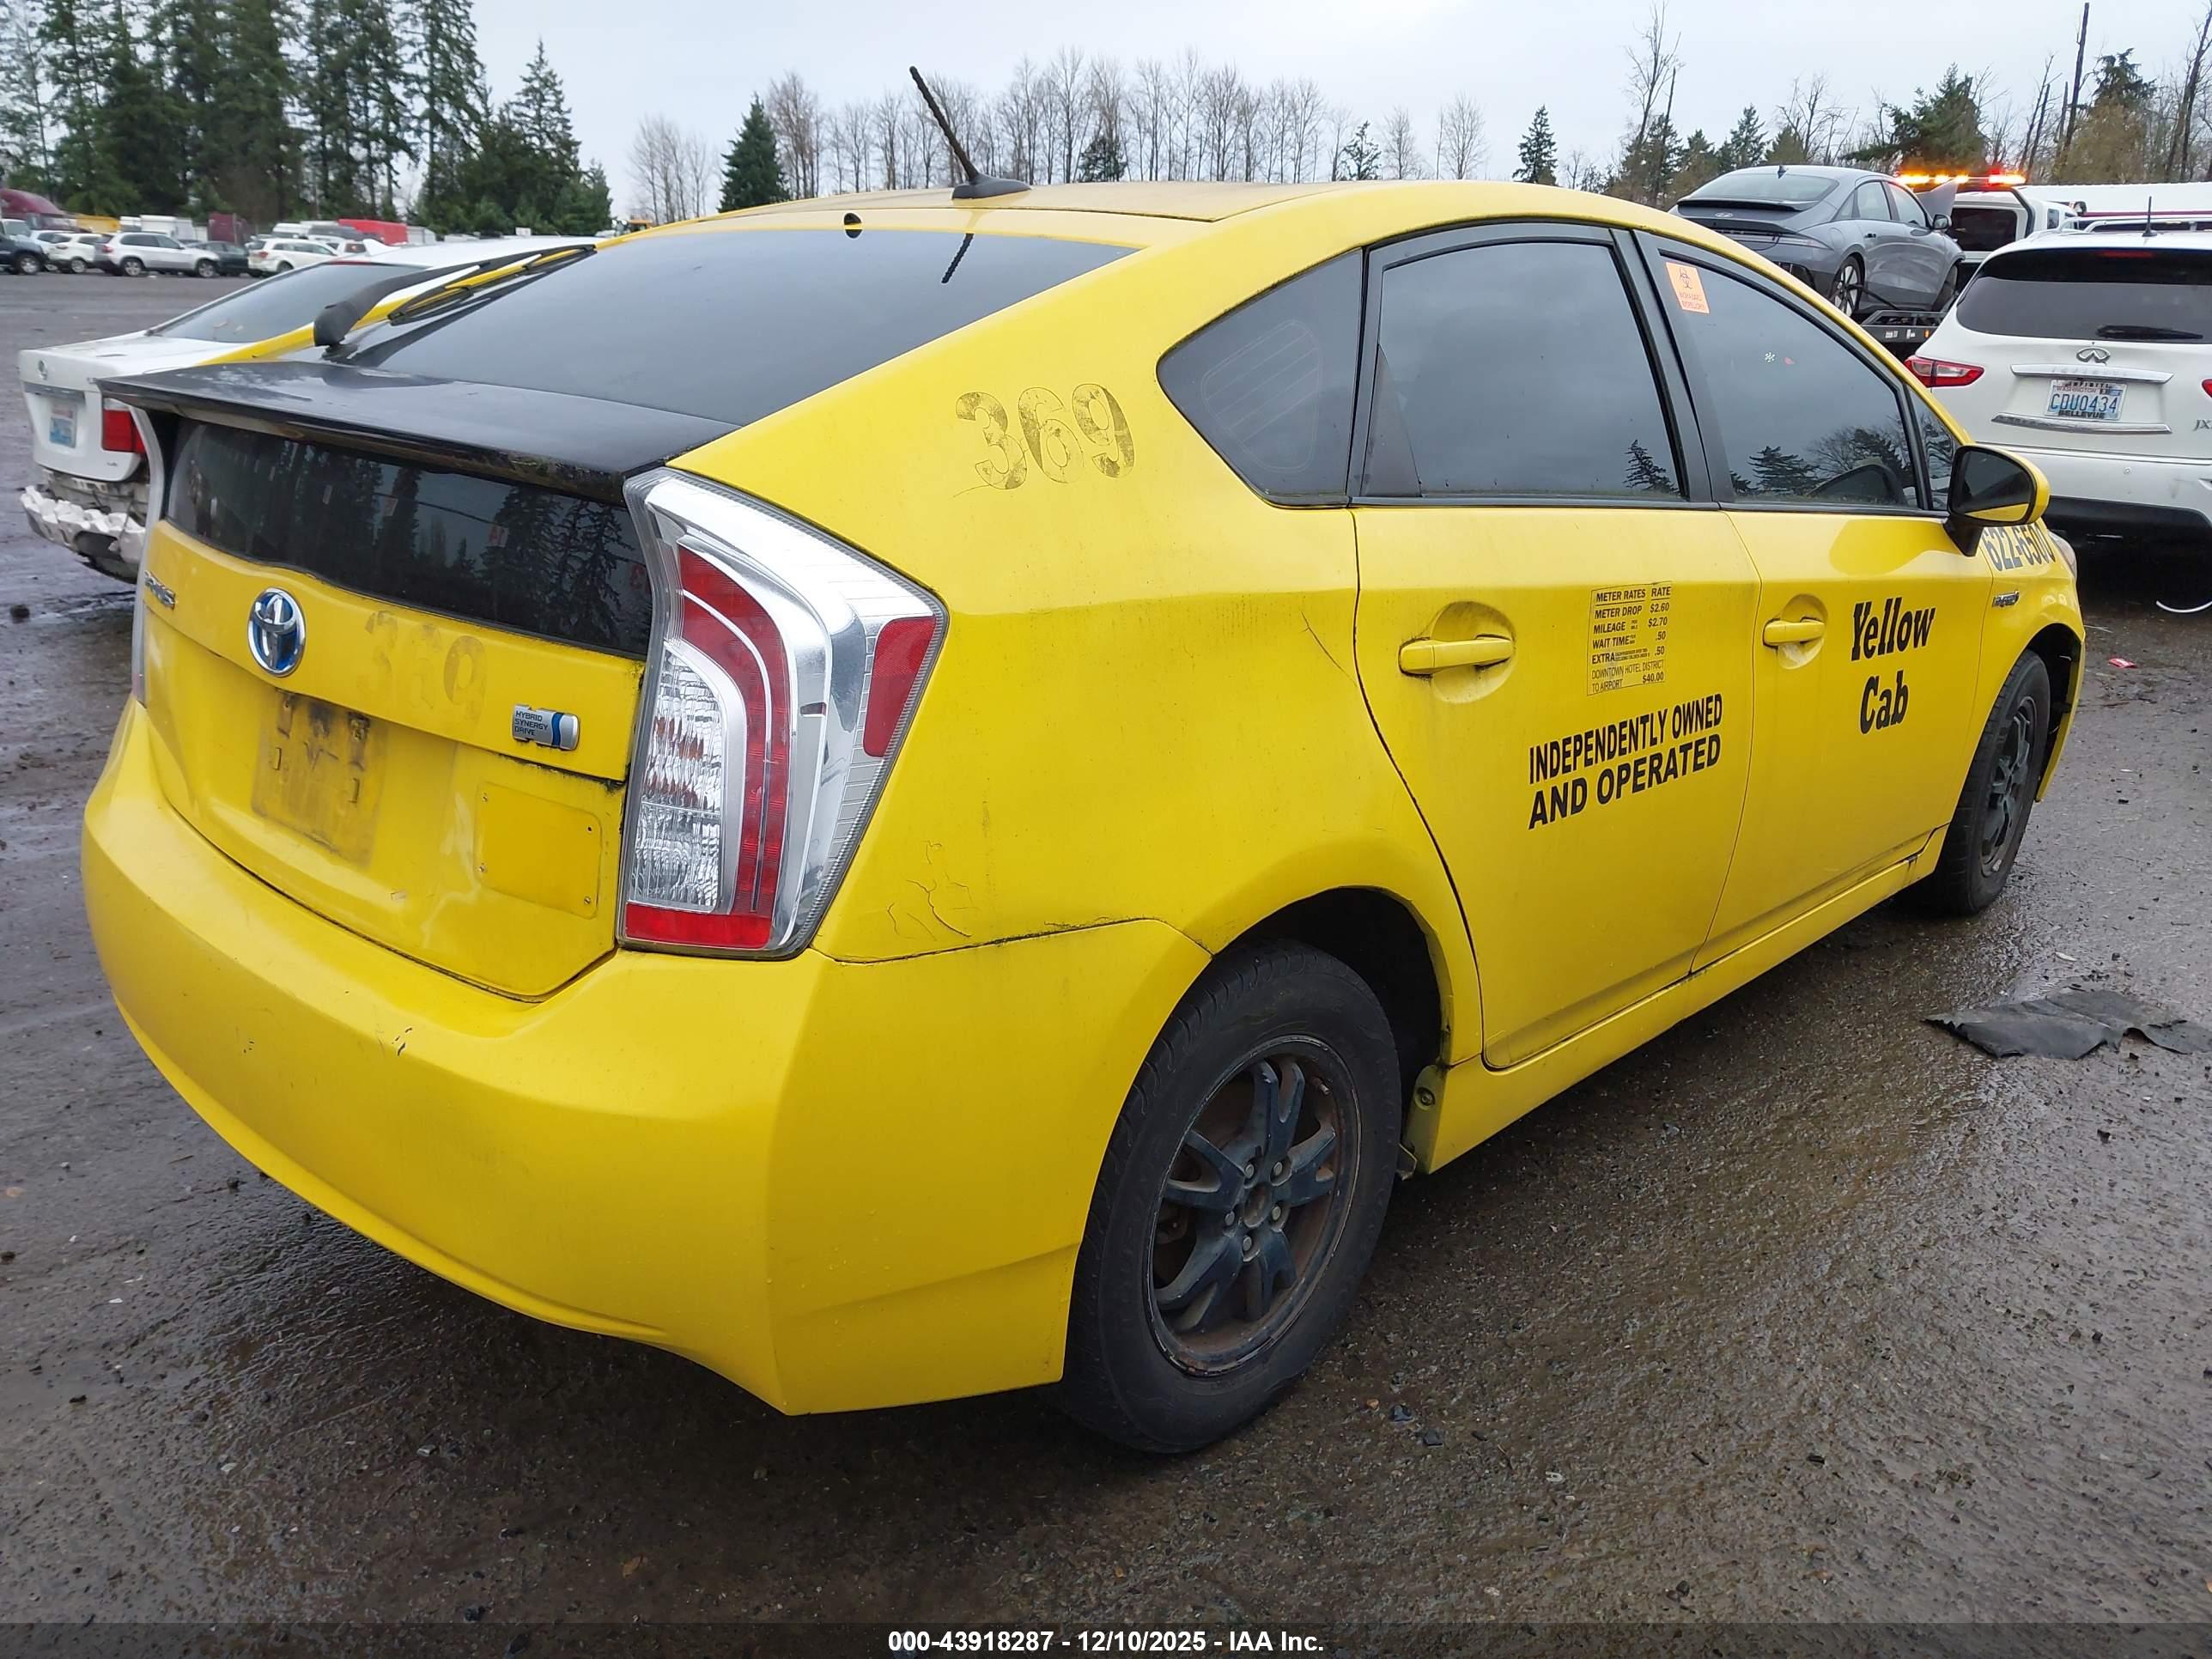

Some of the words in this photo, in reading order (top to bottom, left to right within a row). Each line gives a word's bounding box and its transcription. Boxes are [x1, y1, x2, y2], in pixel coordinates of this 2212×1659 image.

[2051, 393, 2118, 413] CDU0434
[955, 383, 1136, 490] 369
[1595, 591, 1622, 602] METER
[1623, 589, 1646, 600] RATES
[1651, 586, 1671, 597] RATE
[1595, 607, 1620, 619] METER
[1622, 605, 1643, 617] DROP
[1650, 602, 1670, 613] $2.60
[1593, 622, 1626, 635] MILEAGE
[1648, 617, 1668, 629] $2.70
[1851, 596, 1936, 661] Yellow
[1592, 638, 1612, 649] WAIT
[1612, 635, 1630, 647] TIME
[1655, 631, 1666, 641] .50
[1592, 653, 1615, 665] EXTRA
[1654, 646, 1665, 656] .50
[1591, 666, 1625, 680] DOWNTOWN
[1625, 663, 1642, 674] HOTEL
[1642, 659, 1664, 671] DISTRICT
[1592, 682, 1600, 692] TO
[1600, 679, 1623, 690] AIRPORT
[1642, 672, 1664, 684] $40.00
[1860, 670, 1910, 735] Cab
[514, 718, 549, 731] SYNERGY
[515, 710, 543, 722] HYBRID
[514, 726, 536, 736] DRIVE
[1529, 708, 1668, 785] INDEPENDENTLY
[1672, 693, 1723, 739] OWNED
[1528, 777, 1588, 830] AND
[1596, 733, 1722, 805] OPERATED
